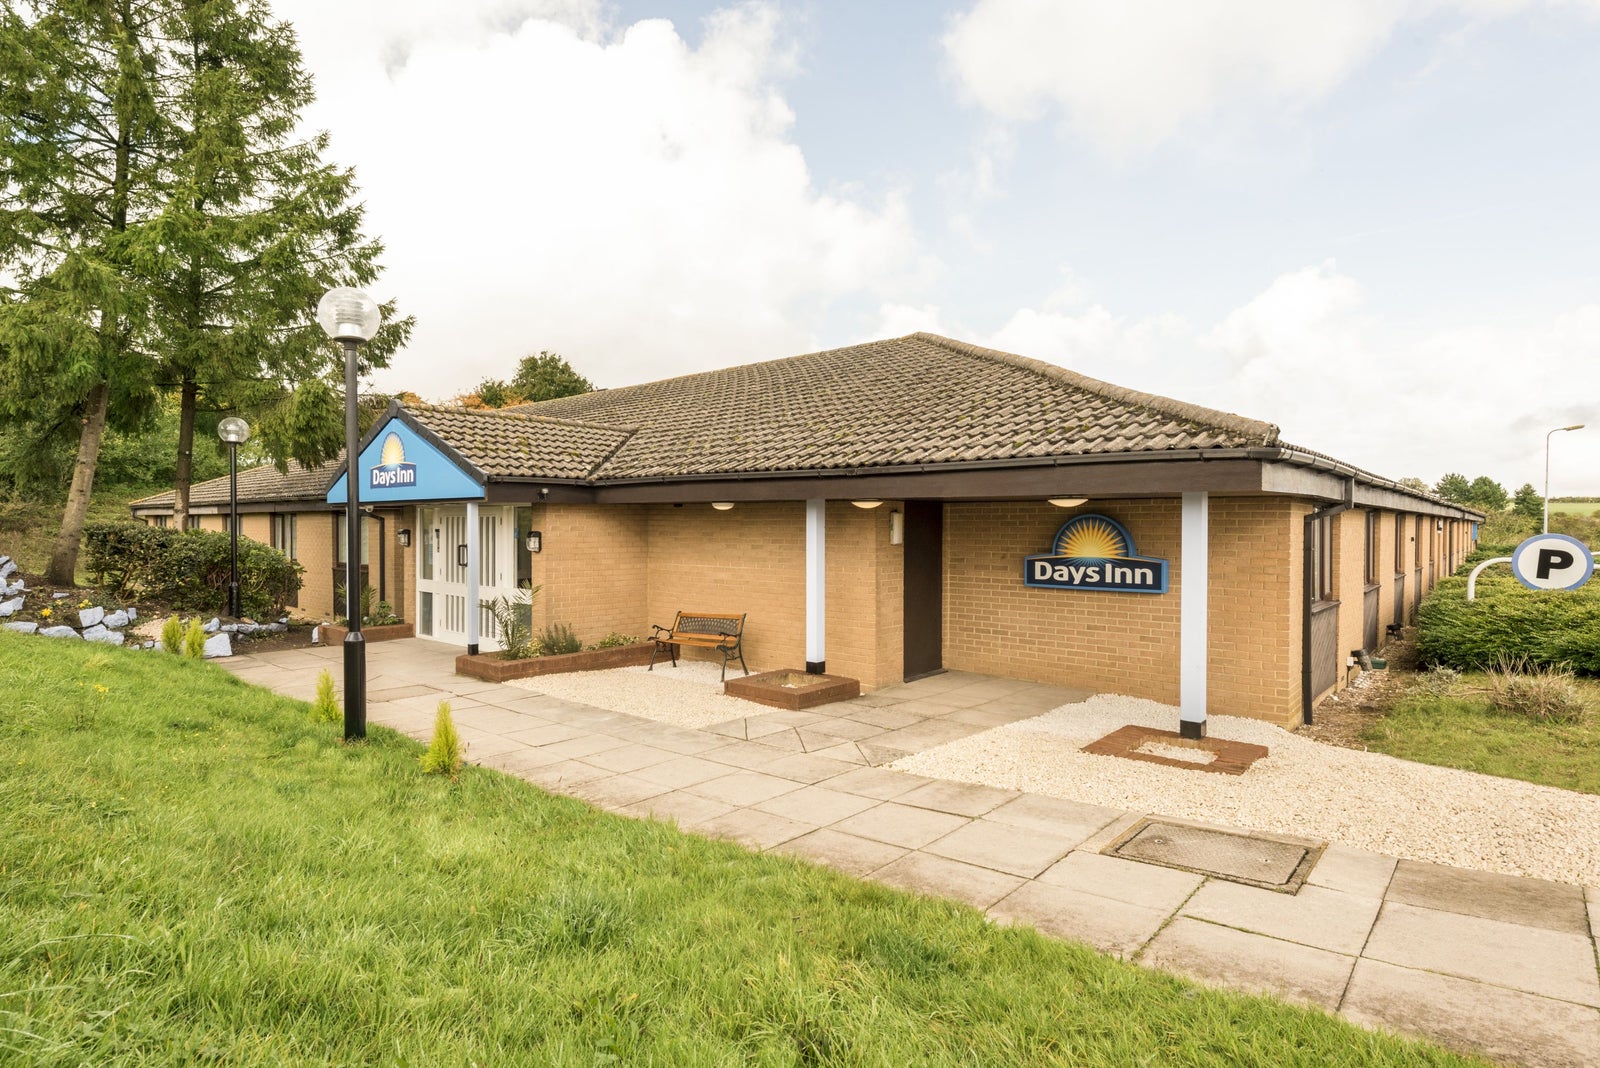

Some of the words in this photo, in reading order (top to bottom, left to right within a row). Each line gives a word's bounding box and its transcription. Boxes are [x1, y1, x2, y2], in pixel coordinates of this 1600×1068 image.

[372, 469, 396, 486] Days
[396, 467, 414, 483] Inn
[1034, 561, 1100, 585] Days
[1105, 563, 1153, 585] Inn
[1536, 548, 1574, 579] P
